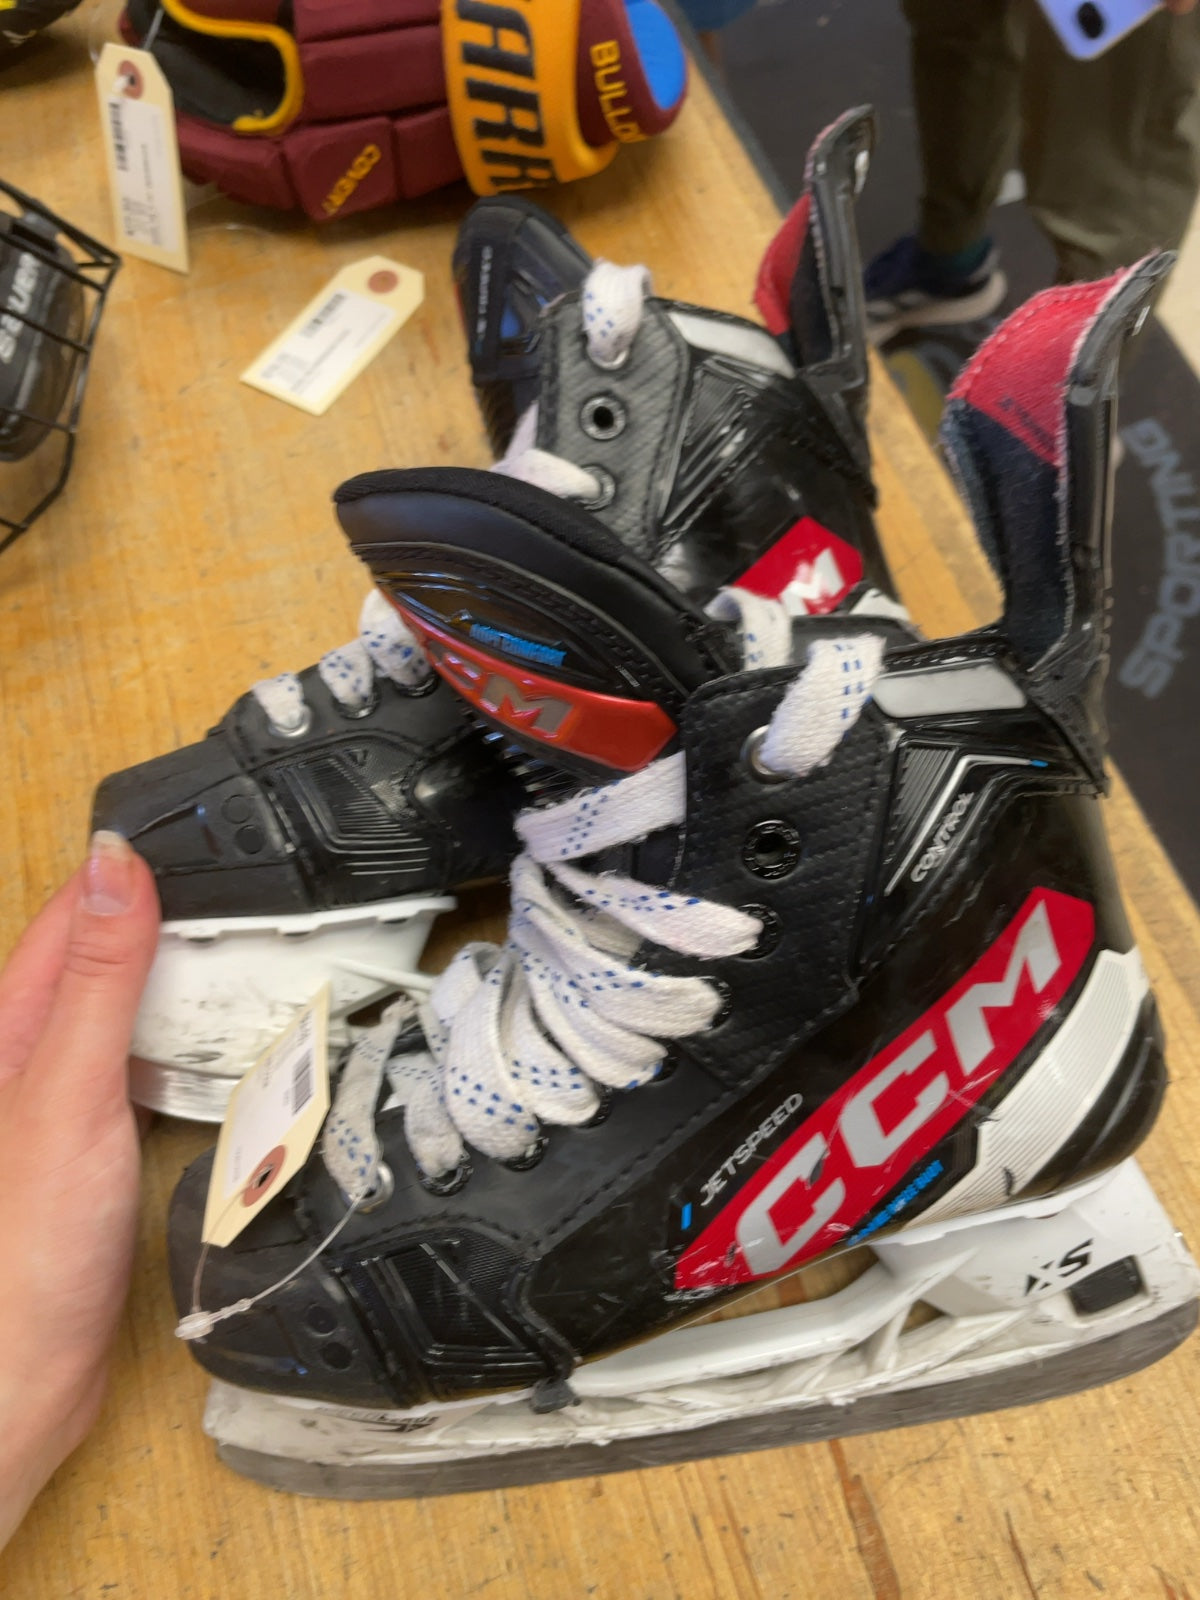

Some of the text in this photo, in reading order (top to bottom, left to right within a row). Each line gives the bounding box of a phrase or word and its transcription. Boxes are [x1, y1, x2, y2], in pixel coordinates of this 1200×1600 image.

[1121, 416, 1200, 698] SPORTING
[701, 1093, 803, 1206] JETSPEED
[736, 900, 1062, 1276] CCM
